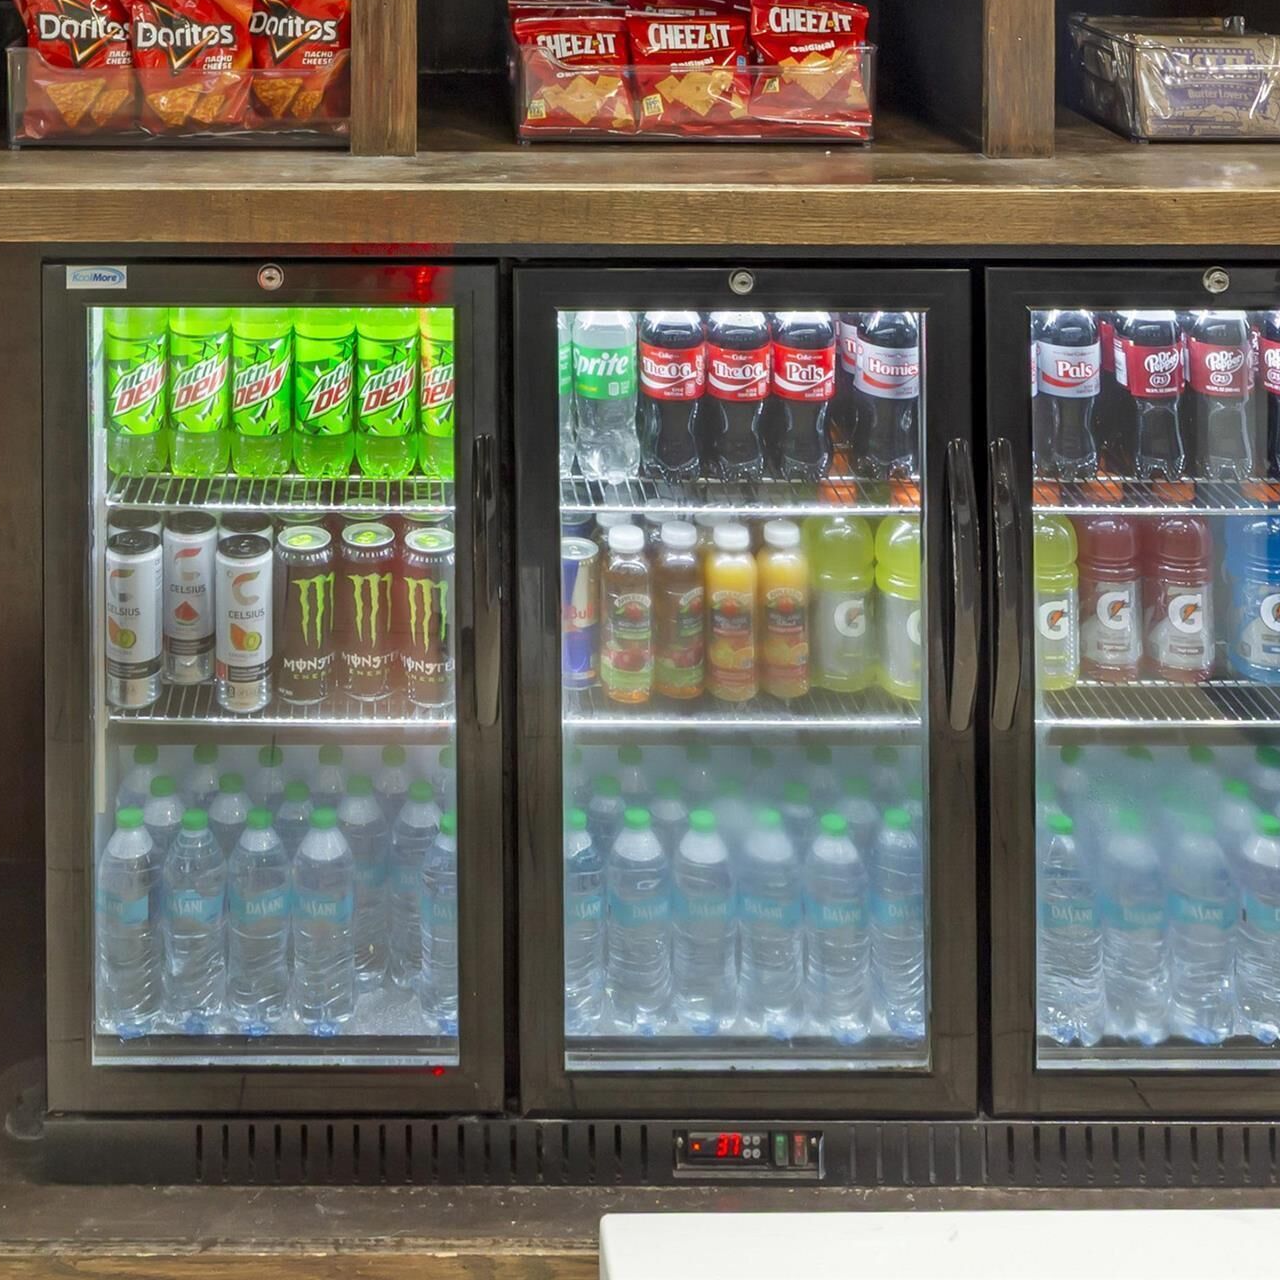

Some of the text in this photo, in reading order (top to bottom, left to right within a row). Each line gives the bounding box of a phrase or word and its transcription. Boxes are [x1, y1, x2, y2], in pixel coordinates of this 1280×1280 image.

[136, 22, 234, 48] Doritos
[249, 12, 338, 42] Doritos
[303, 50, 334, 59] NACHO
[72, 272, 118, 283] KoolMore
[573, 348, 629, 377] Sprite
[642, 358, 692, 379] The OG
[713, 360, 763, 380] The OG
[785, 361, 825, 383] Pals
[869, 357, 919, 376] Homies
[1055, 359, 1094, 378] Pals
[170, 583, 207, 594] CELSIUS
[228, 608, 266, 619] CELSIUS
[246, 897, 284, 915] DASANI
